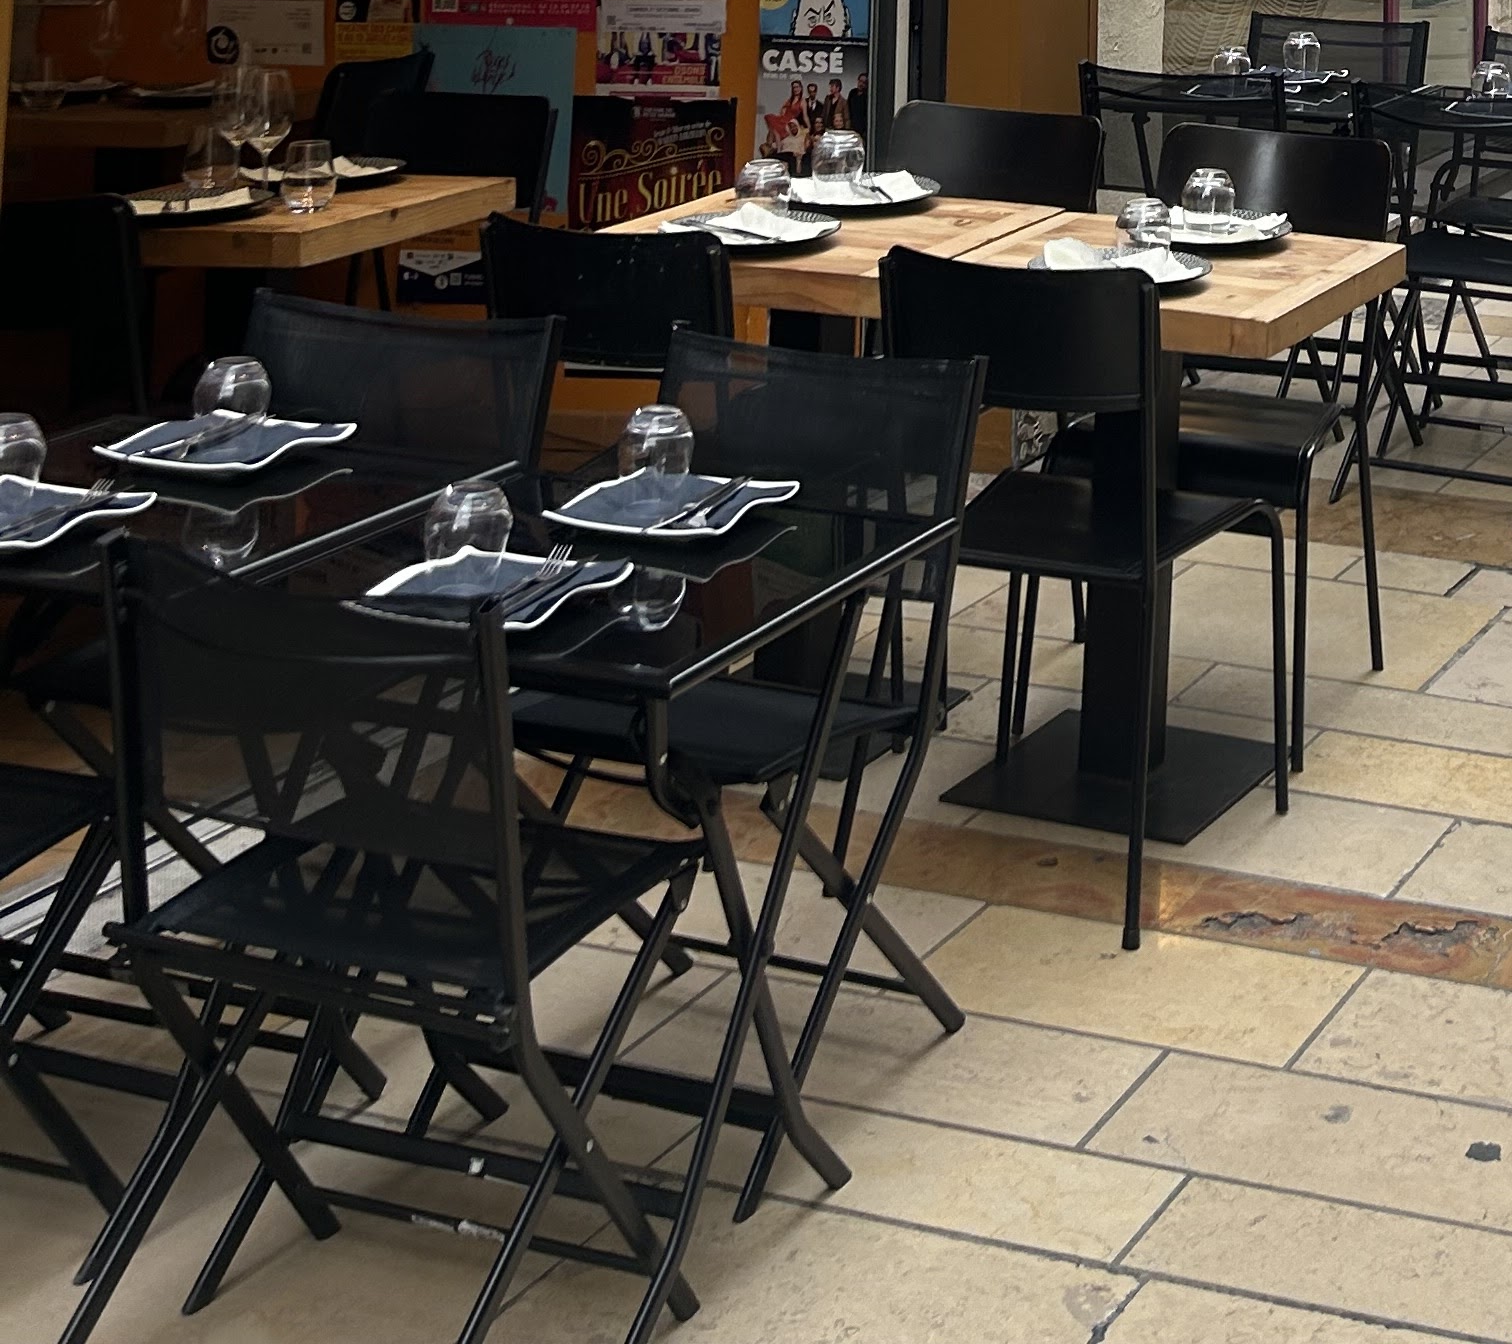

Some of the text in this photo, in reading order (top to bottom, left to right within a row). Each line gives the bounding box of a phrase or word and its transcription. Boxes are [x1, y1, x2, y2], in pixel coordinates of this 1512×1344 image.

[762, 47, 844, 75] CASSÉ
[578, 160, 723, 224] Une Soirée
